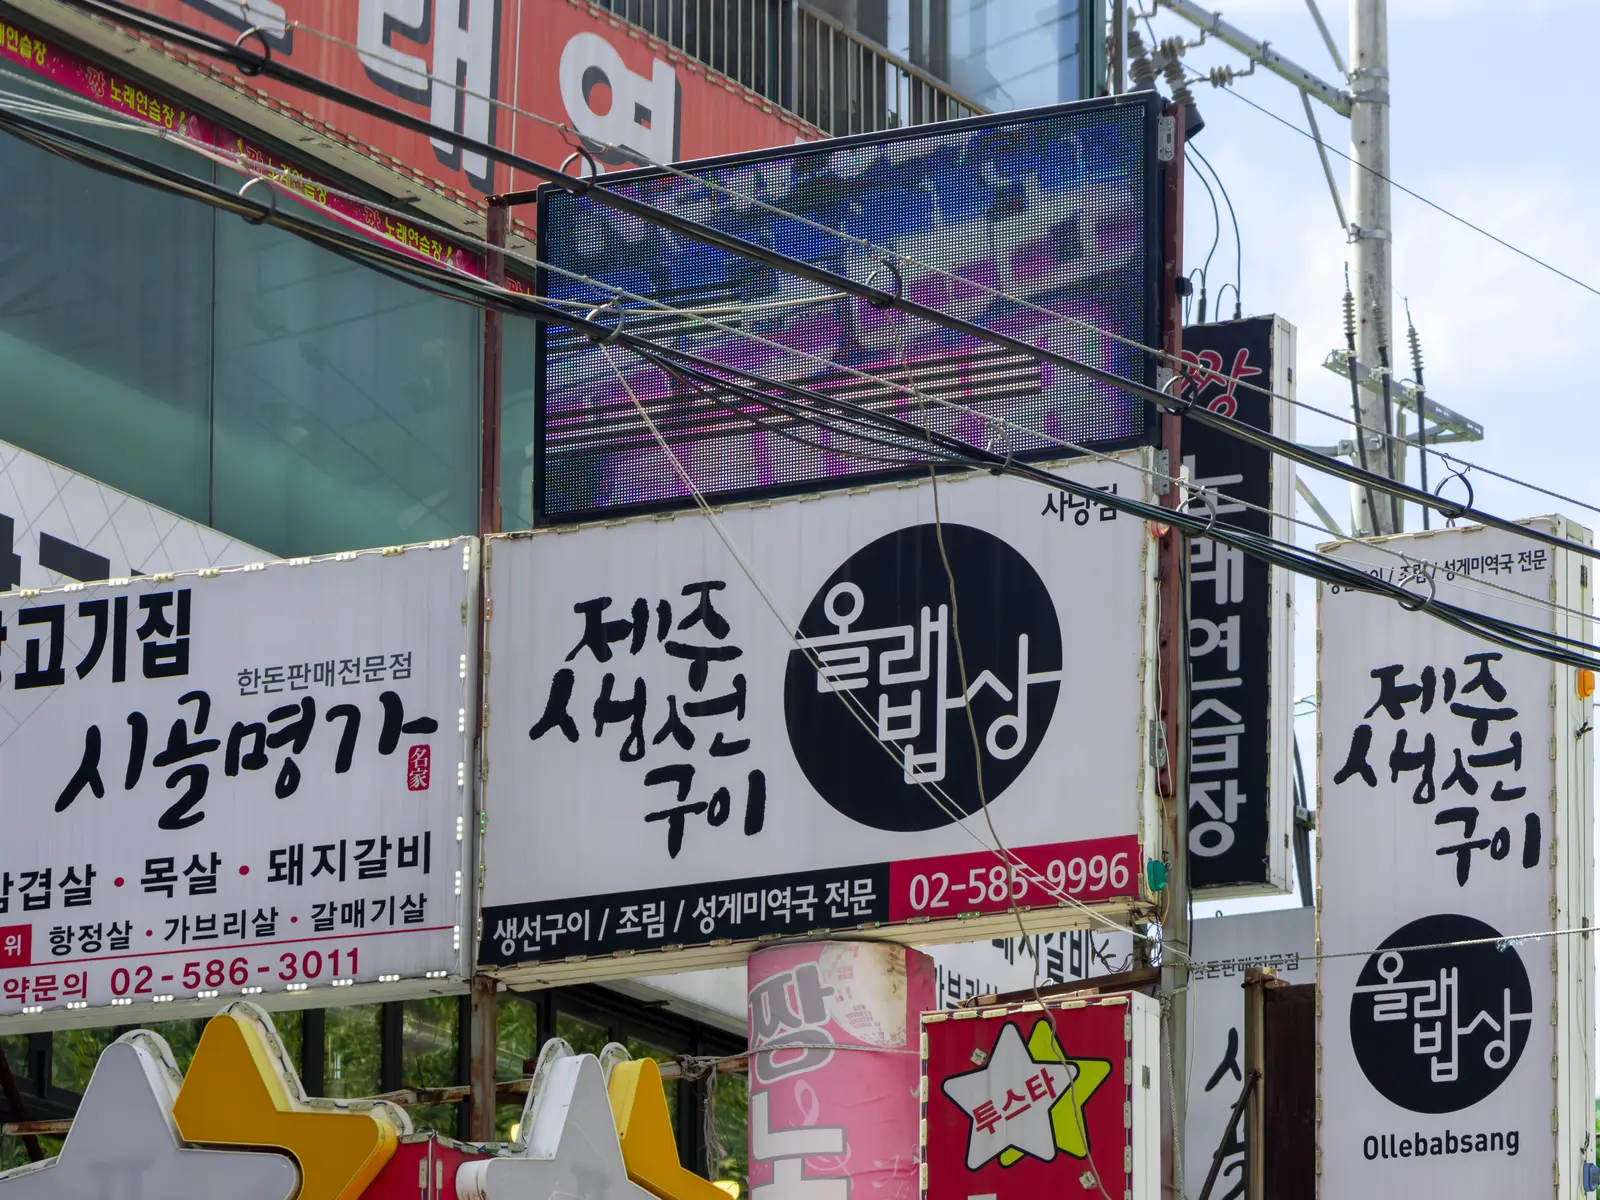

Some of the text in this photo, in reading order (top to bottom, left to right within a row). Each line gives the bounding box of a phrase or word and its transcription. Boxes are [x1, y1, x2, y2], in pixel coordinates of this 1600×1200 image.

[110, 78, 175, 128] 노래연습장
[385, 216, 443, 264] 노래연습장
[1443, 553, 1516, 581] 성게미역국
[1518, 549, 1548, 573] 전문
[0, 588, 192, 690] 고기집
[565, 580, 743, 692] 제주
[237, 652, 413, 696] 한돈판매전문점
[1364, 652, 1518, 745] 제주
[529, 668, 750, 762] 생선
[55, 690, 439, 830] 시골명가
[409, 746, 430, 790] 名家
[1334, 724, 1527, 804] 생선
[644, 764, 766, 859] 구이
[140, 852, 222, 898] 목살
[267, 831, 431, 886] 돼지갈비
[1434, 806, 1541, 886] 구이
[909, 852, 1129, 910] 02-585-9996
[49, 920, 133, 956] 항정살
[164, 906, 279, 945] 가브리살
[311, 893, 428, 932] 갈매기살
[493, 908, 590, 956] 생선구이
[615, 900, 665, 938] 조림
[692, 884, 818, 936] 성게미역국
[825, 878, 877, 919] 전문
[3, 971, 88, 1004] 약문의
[972, 1067, 1057, 1135] 투스타
[1363, 1129, 1520, 1161] Ollebabsang
